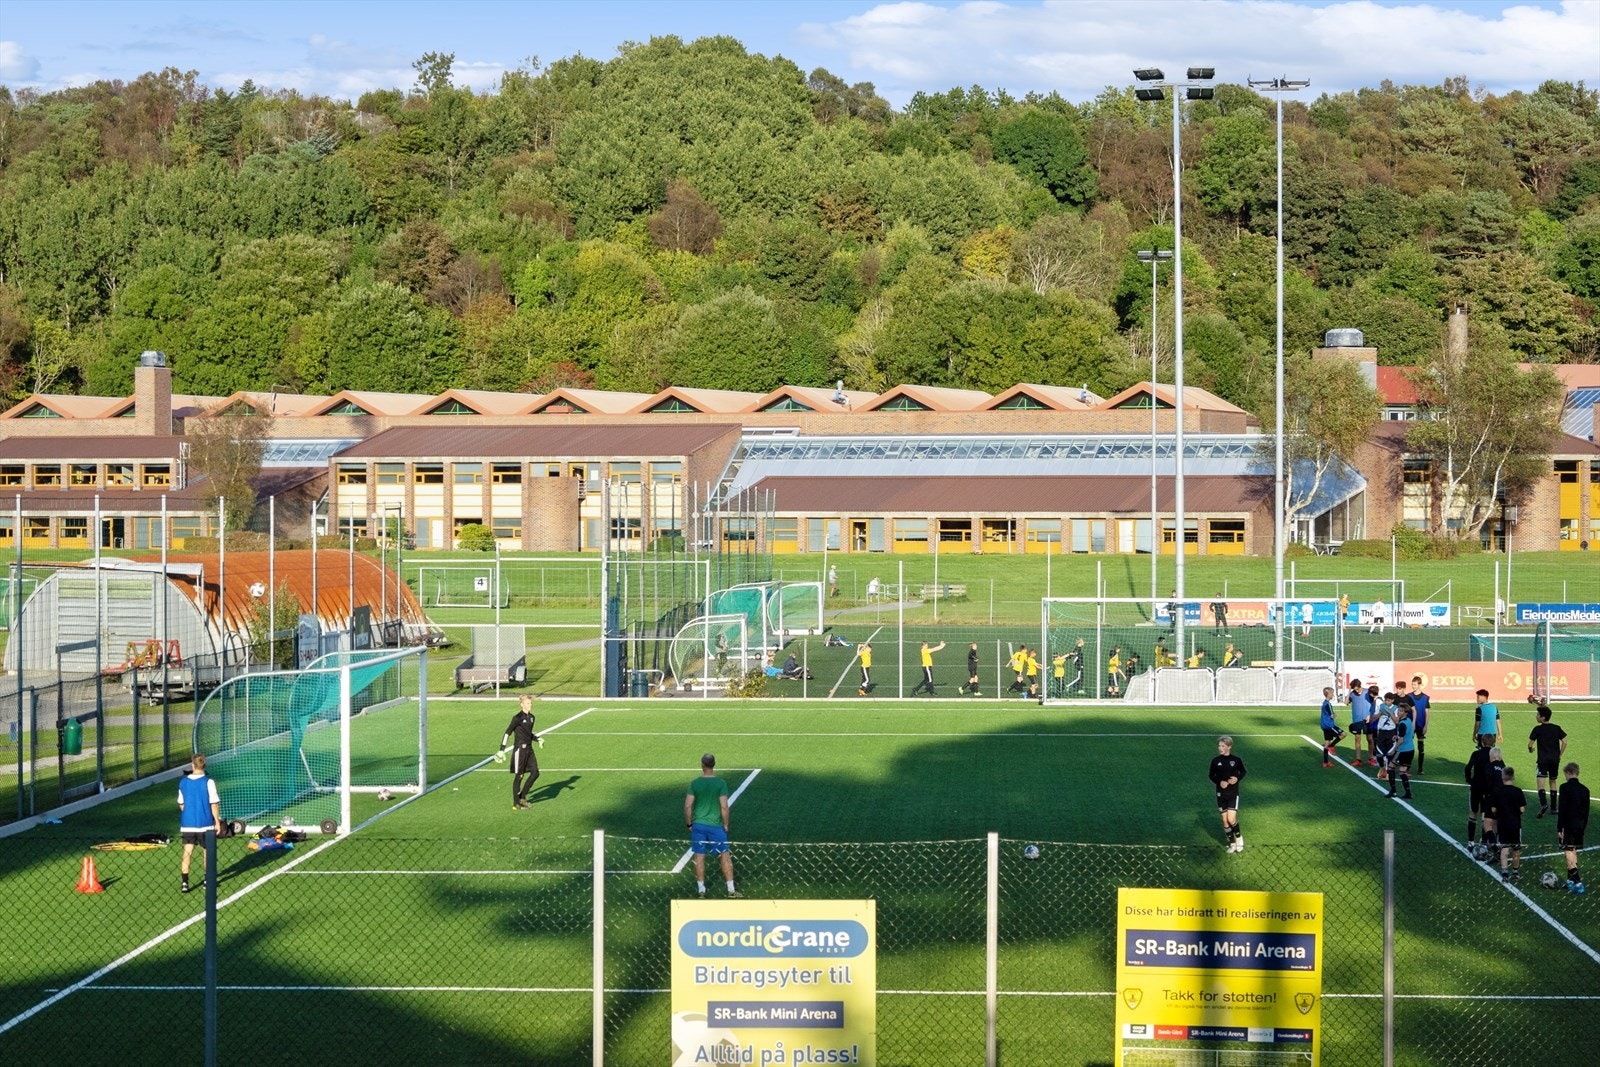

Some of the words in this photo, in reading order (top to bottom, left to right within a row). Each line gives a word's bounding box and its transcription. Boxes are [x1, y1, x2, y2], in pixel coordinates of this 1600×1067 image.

[477, 578, 484, 587] 4
[1432, 676, 1475, 686] EXTRA
[1125, 906, 1153, 916] Disse
[1156, 907, 1173, 917] har
[1177, 907, 1213, 918] bidratt
[1216, 908, 1228, 918] til
[1230, 909, 1301, 921] realiseringen
[1303, 912, 1317, 921] av
[1135, 939, 1209, 956] SR-Bank
[1214, 941, 1250, 958] Mini
[1255, 942, 1306, 959] Arena
[695, 966, 823, 988] Bidragsyter
[829, 966, 852, 984] til
[1162, 989, 1195, 1001] Takk
[1198, 990, 1219, 1002] for
[714, 1007, 768, 1020] SR-Bank
[771, 1007, 798, 1020] Mini
[800, 1007, 837, 1020] Arena
[695, 1045, 754, 1064] Alltid
[761, 1042, 786, 1067] på
[793, 1045, 859, 1067] plass!
